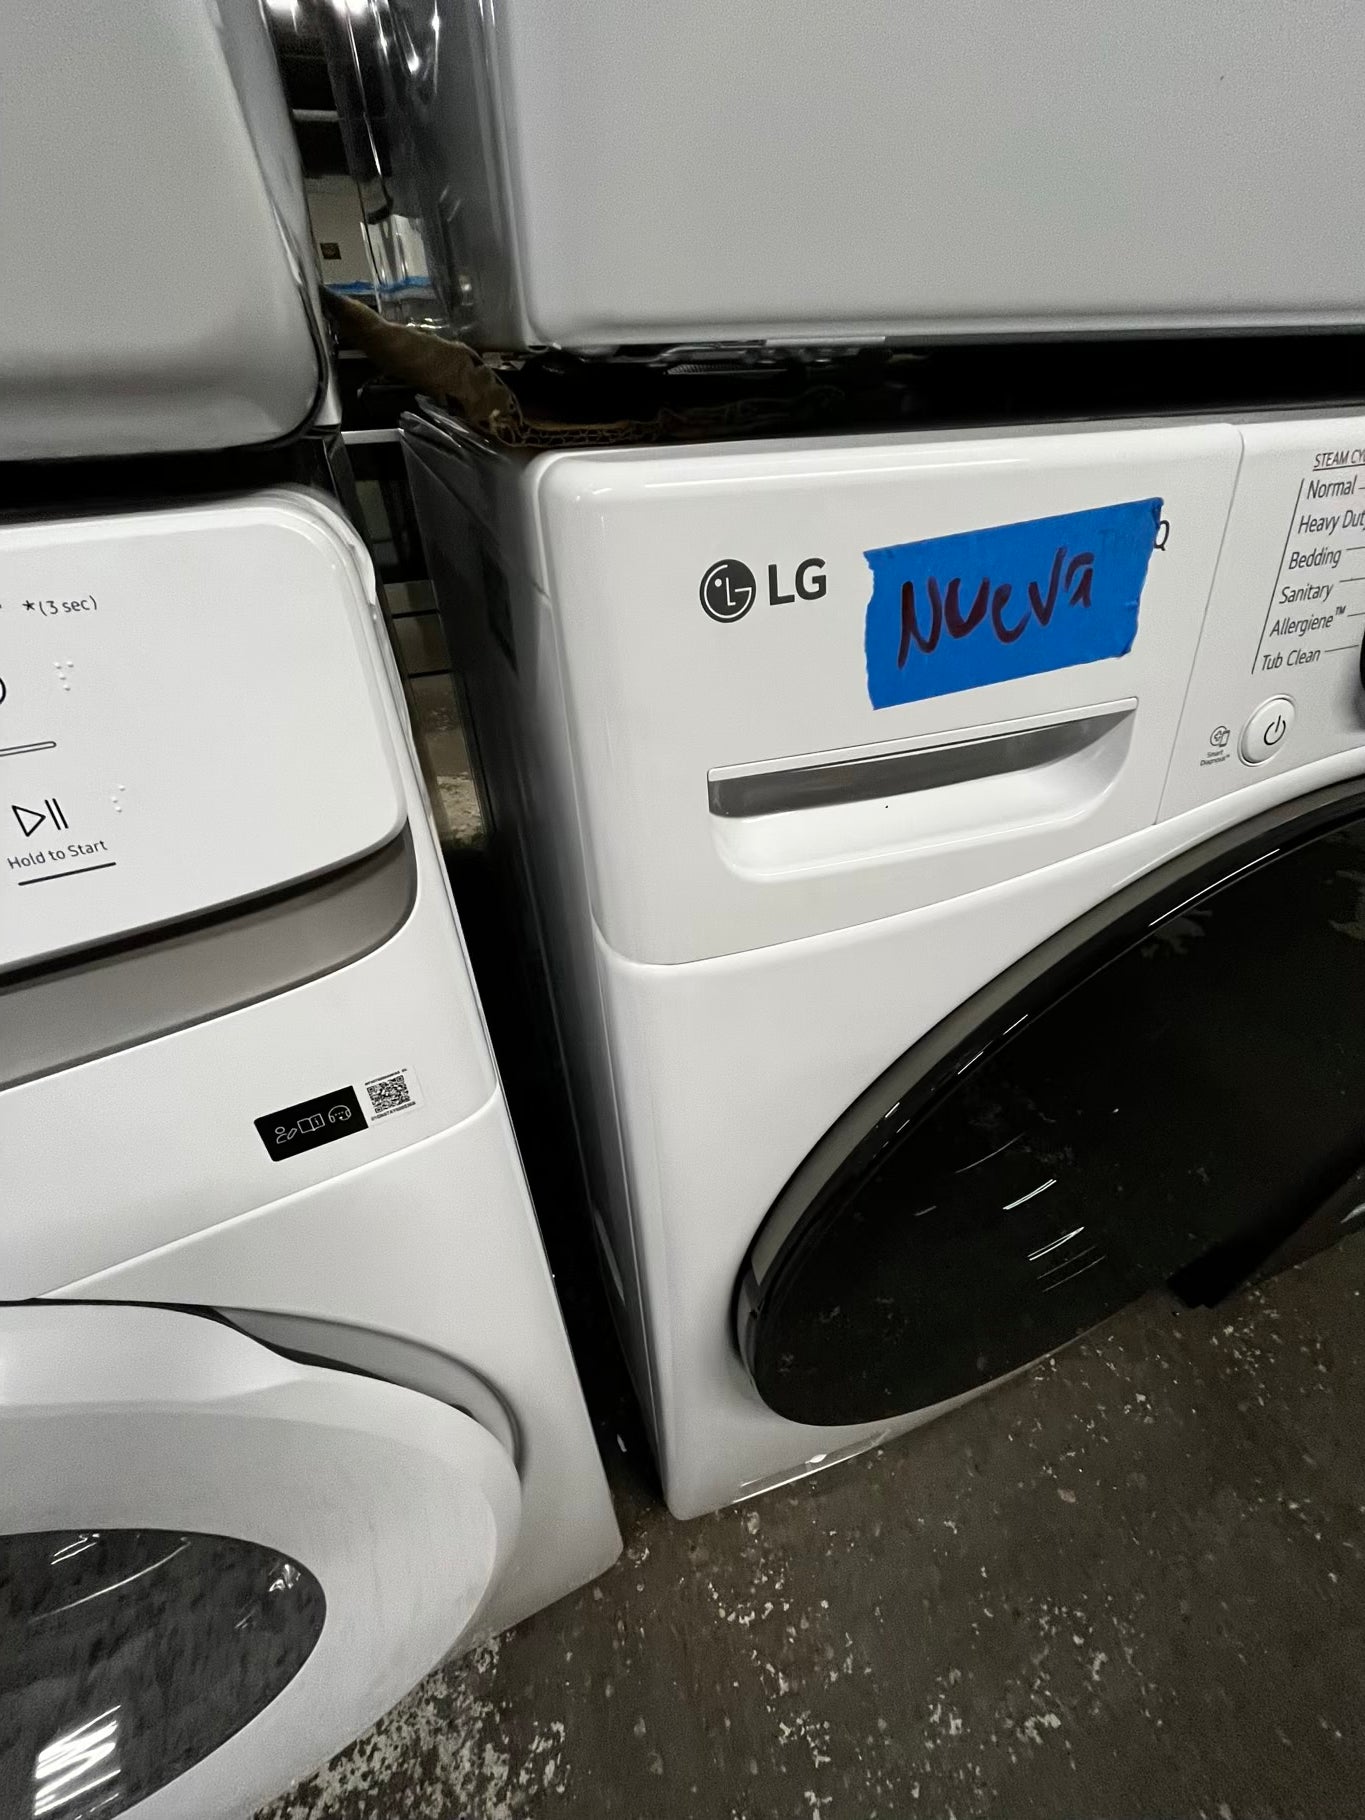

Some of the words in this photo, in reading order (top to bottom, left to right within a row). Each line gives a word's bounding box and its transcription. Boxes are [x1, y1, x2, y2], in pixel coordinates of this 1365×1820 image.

[1313, 451, 1350, 468] STEAM
[1351, 449, 1365, 464] CY
[1307, 475, 1357, 499] Normal
[1298, 514, 1340, 535] Heavy
[1289, 547, 1342, 570] Bedding
[769, 556, 827, 606] LG
[1279, 583, 1333, 604] Sanitary
[1261, 652, 1284, 671] Tub
[1286, 648, 1321, 666] Clean
[7, 851, 46, 870] Hold
[48, 849, 66, 861] to
[67, 840, 108, 857] Start
